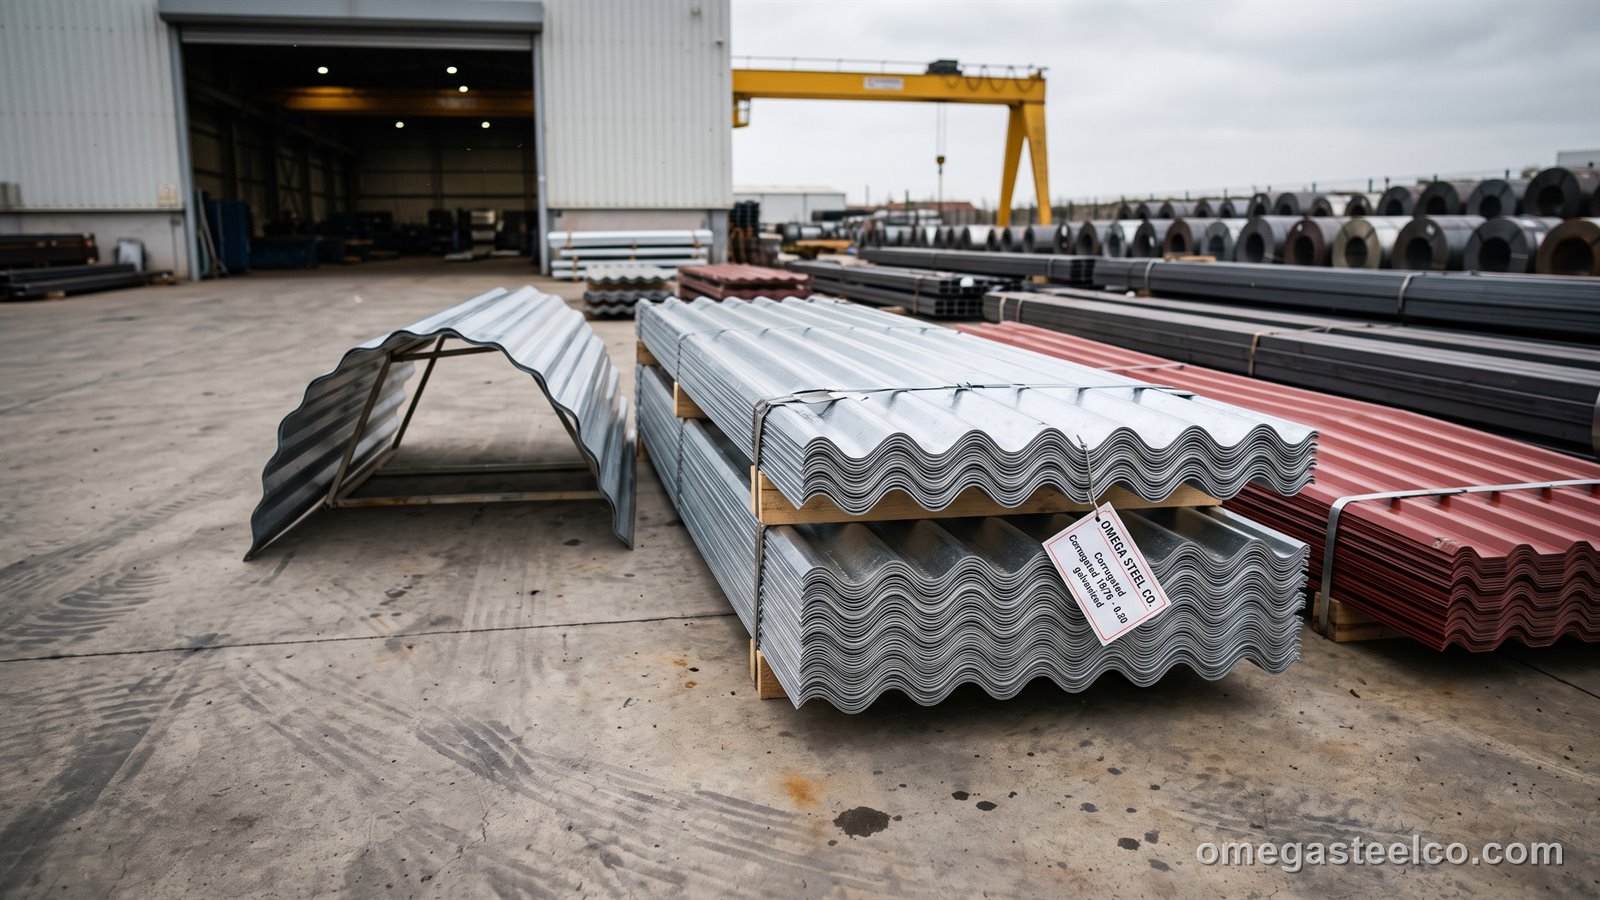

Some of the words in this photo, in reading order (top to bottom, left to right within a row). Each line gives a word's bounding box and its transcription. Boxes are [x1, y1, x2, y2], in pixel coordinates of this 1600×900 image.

[1069, 534, 1100, 578] Corrugated
[1097, 578, 1113, 600] 18/76
[1094, 552, 1126, 597] Corrugated
[1101, 520, 1127, 558] OMEGA
[1124, 558, 1145, 589] STEEL
[1142, 589, 1155, 607] CO.
